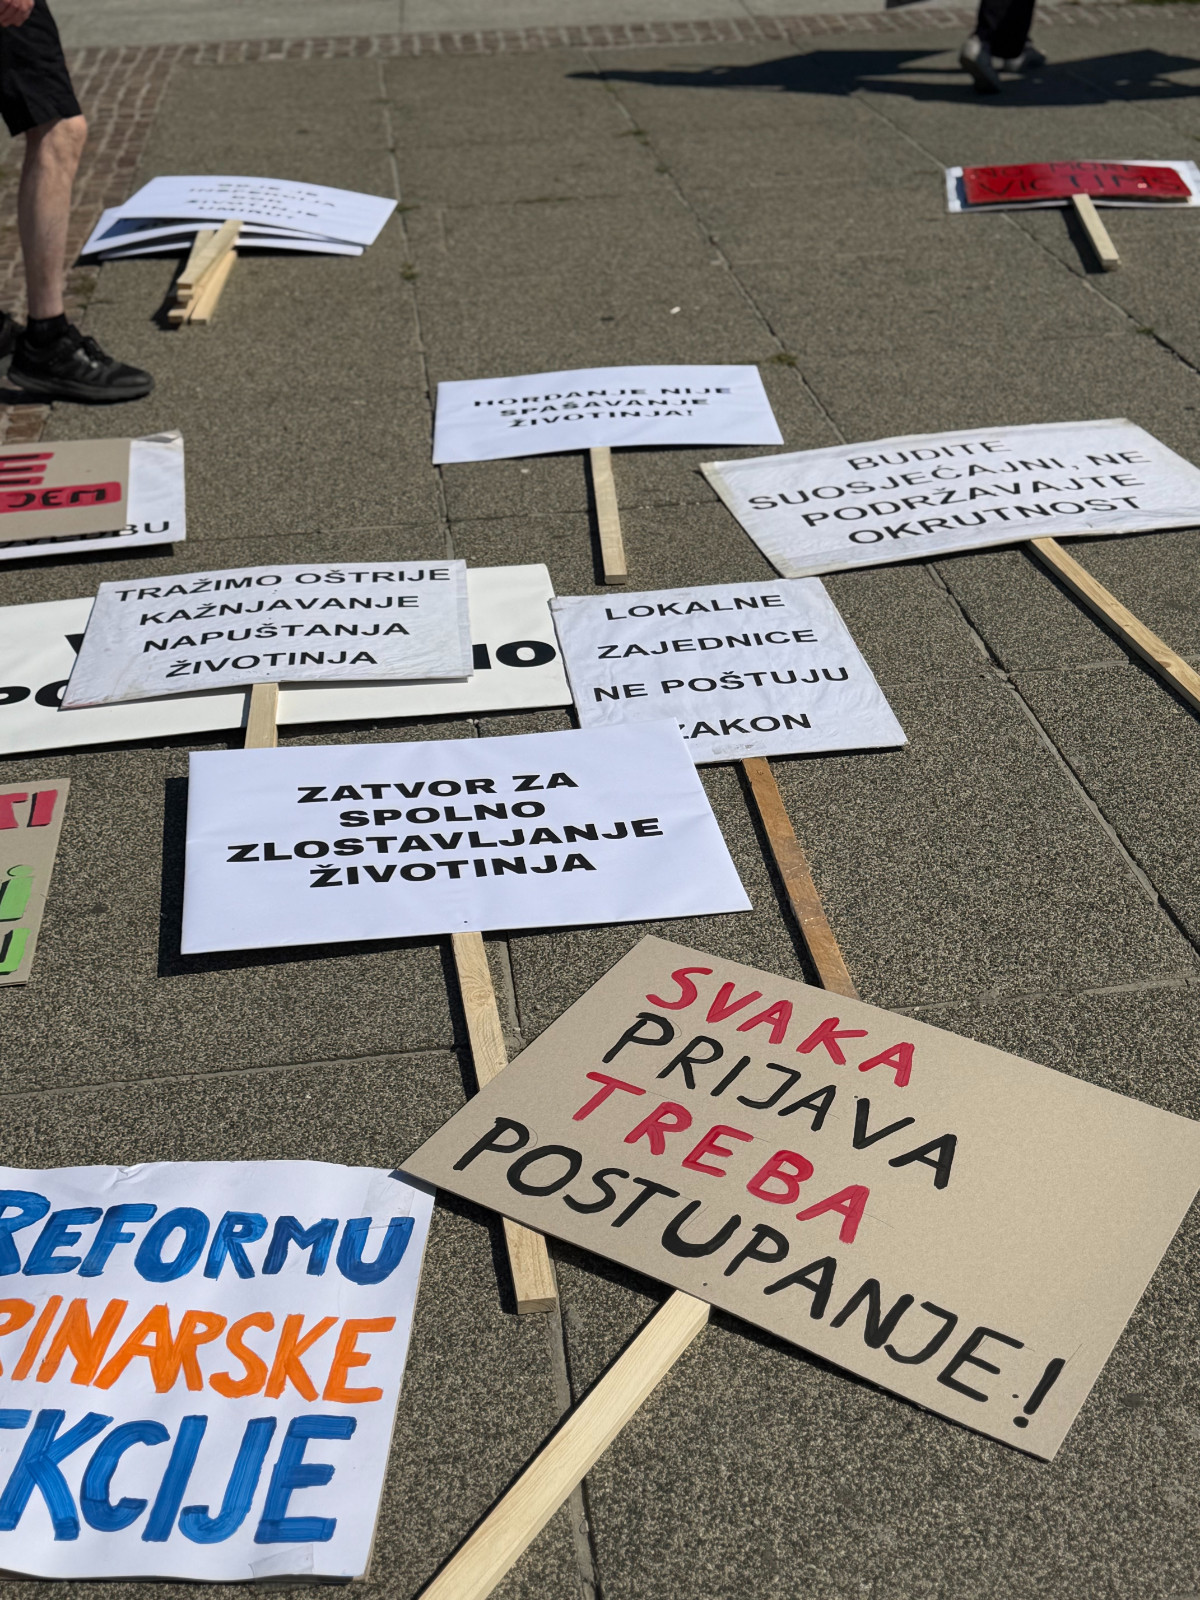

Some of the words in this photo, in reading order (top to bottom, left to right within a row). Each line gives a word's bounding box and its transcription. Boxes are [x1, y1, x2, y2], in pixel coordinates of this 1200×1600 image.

[979, 175, 1182, 196] VICTIMS
[474, 388, 650, 407] HORDANJE
[660, 386, 733, 396] NIJE
[500, 398, 711, 417] SPAŠAVANJE
[508, 409, 694, 428] ŽIVOTINJA!
[847, 439, 1018, 471] BUDITE
[747, 456, 1081, 511] SUOSJEĆAJNI,
[1086, 450, 1152, 466] NE
[800, 473, 1146, 528] PODRŽAVAJTE
[848, 496, 1143, 546] OKRUTNOST
[114, 572, 283, 603] TRAŽIMO
[294, 567, 452, 586] OŠTRIJE
[138, 595, 421, 627] KAŽNJAVANJE
[605, 593, 786, 621] LOKALNE
[142, 621, 411, 653] NAPUŠTANJA
[597, 629, 819, 660] ZAJEDNICE
[164, 650, 379, 678] ŽIVOTINJA
[593, 683, 649, 702] NE
[660, 667, 851, 695] POŠTUJU
[679, 713, 813, 740] AKON
[296, 777, 498, 804] ZATVOR
[511, 771, 580, 792] ZA
[339, 800, 546, 828] SPOLNO
[226, 817, 664, 863] ZLOSTAVLJANJE
[309, 852, 597, 888] ŽIVOTINJA
[645, 966, 916, 1087] SVAKA
[602, 1011, 958, 1190] PRIJAVA
[571, 1071, 871, 1244] TREBA
[0, 1189, 415, 1285] REFORMU
